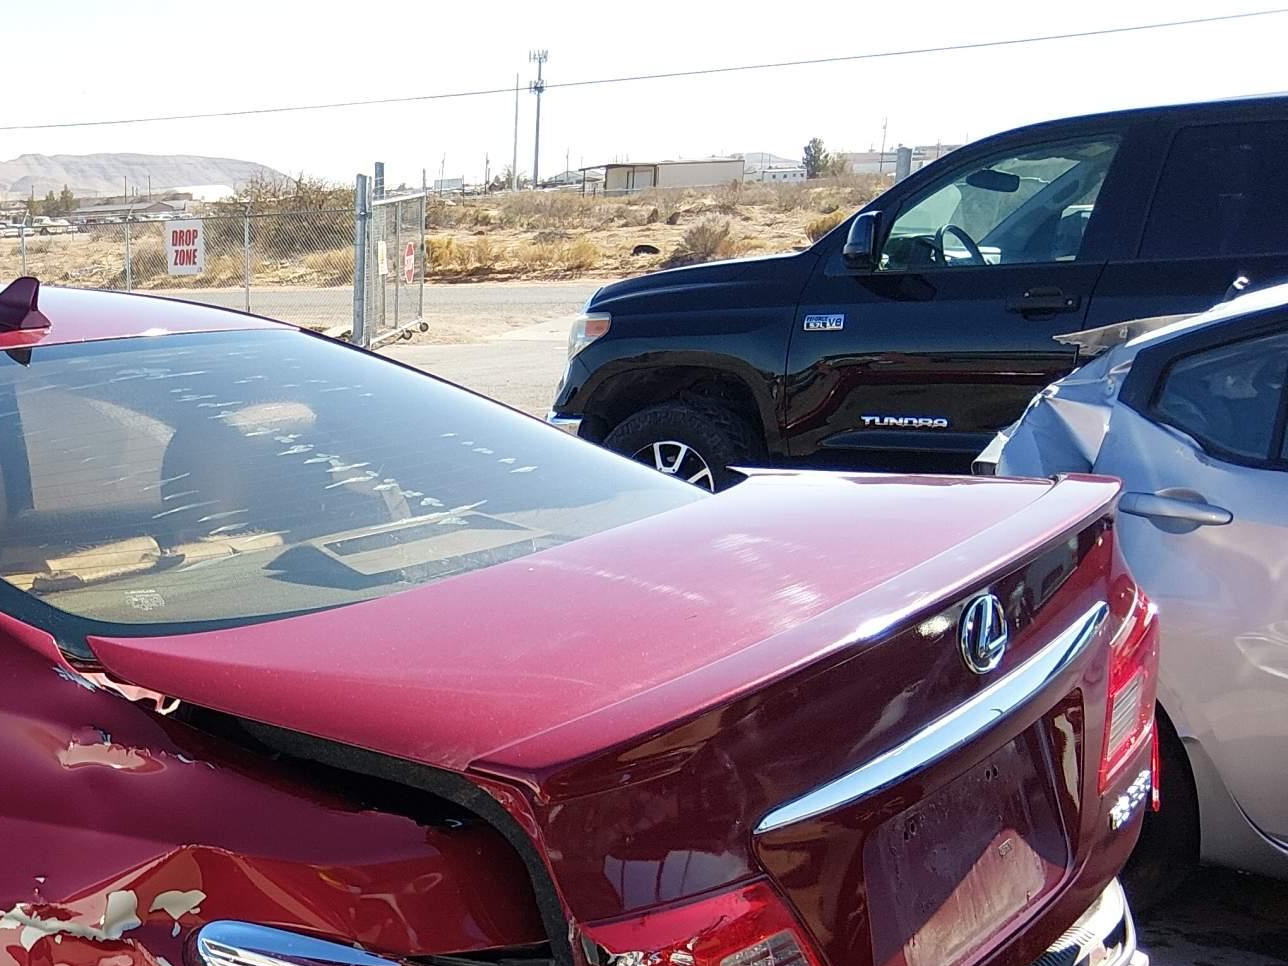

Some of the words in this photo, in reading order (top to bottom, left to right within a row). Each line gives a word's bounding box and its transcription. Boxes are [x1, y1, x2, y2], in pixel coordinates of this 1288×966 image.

[172, 229, 198, 247] DROP
[173, 249, 198, 266] ZONE
[860, 415, 948, 429] TUNDRA
